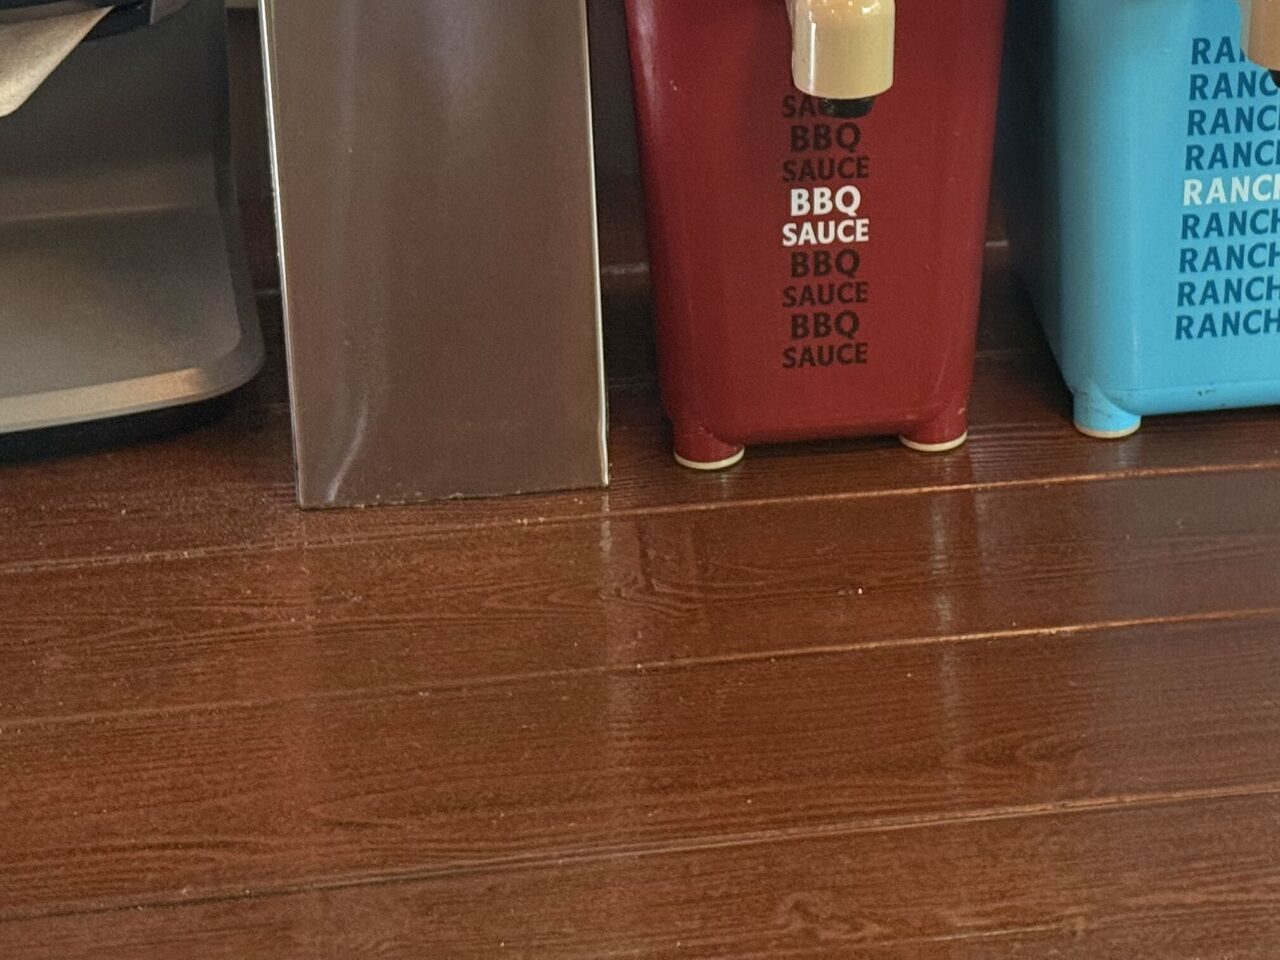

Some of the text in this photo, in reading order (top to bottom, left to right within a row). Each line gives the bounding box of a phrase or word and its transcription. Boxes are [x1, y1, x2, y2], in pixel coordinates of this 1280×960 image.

[790, 121, 862, 153] BBQ
[781, 155, 871, 183] SAUCE
[790, 184, 862, 218] BBQ
[781, 217, 870, 248] SAUCE
[790, 248, 861, 279] BBQ
[781, 281, 870, 309] SAUCE
[790, 309, 861, 341] BBQ
[781, 342, 869, 370] SAUCE
